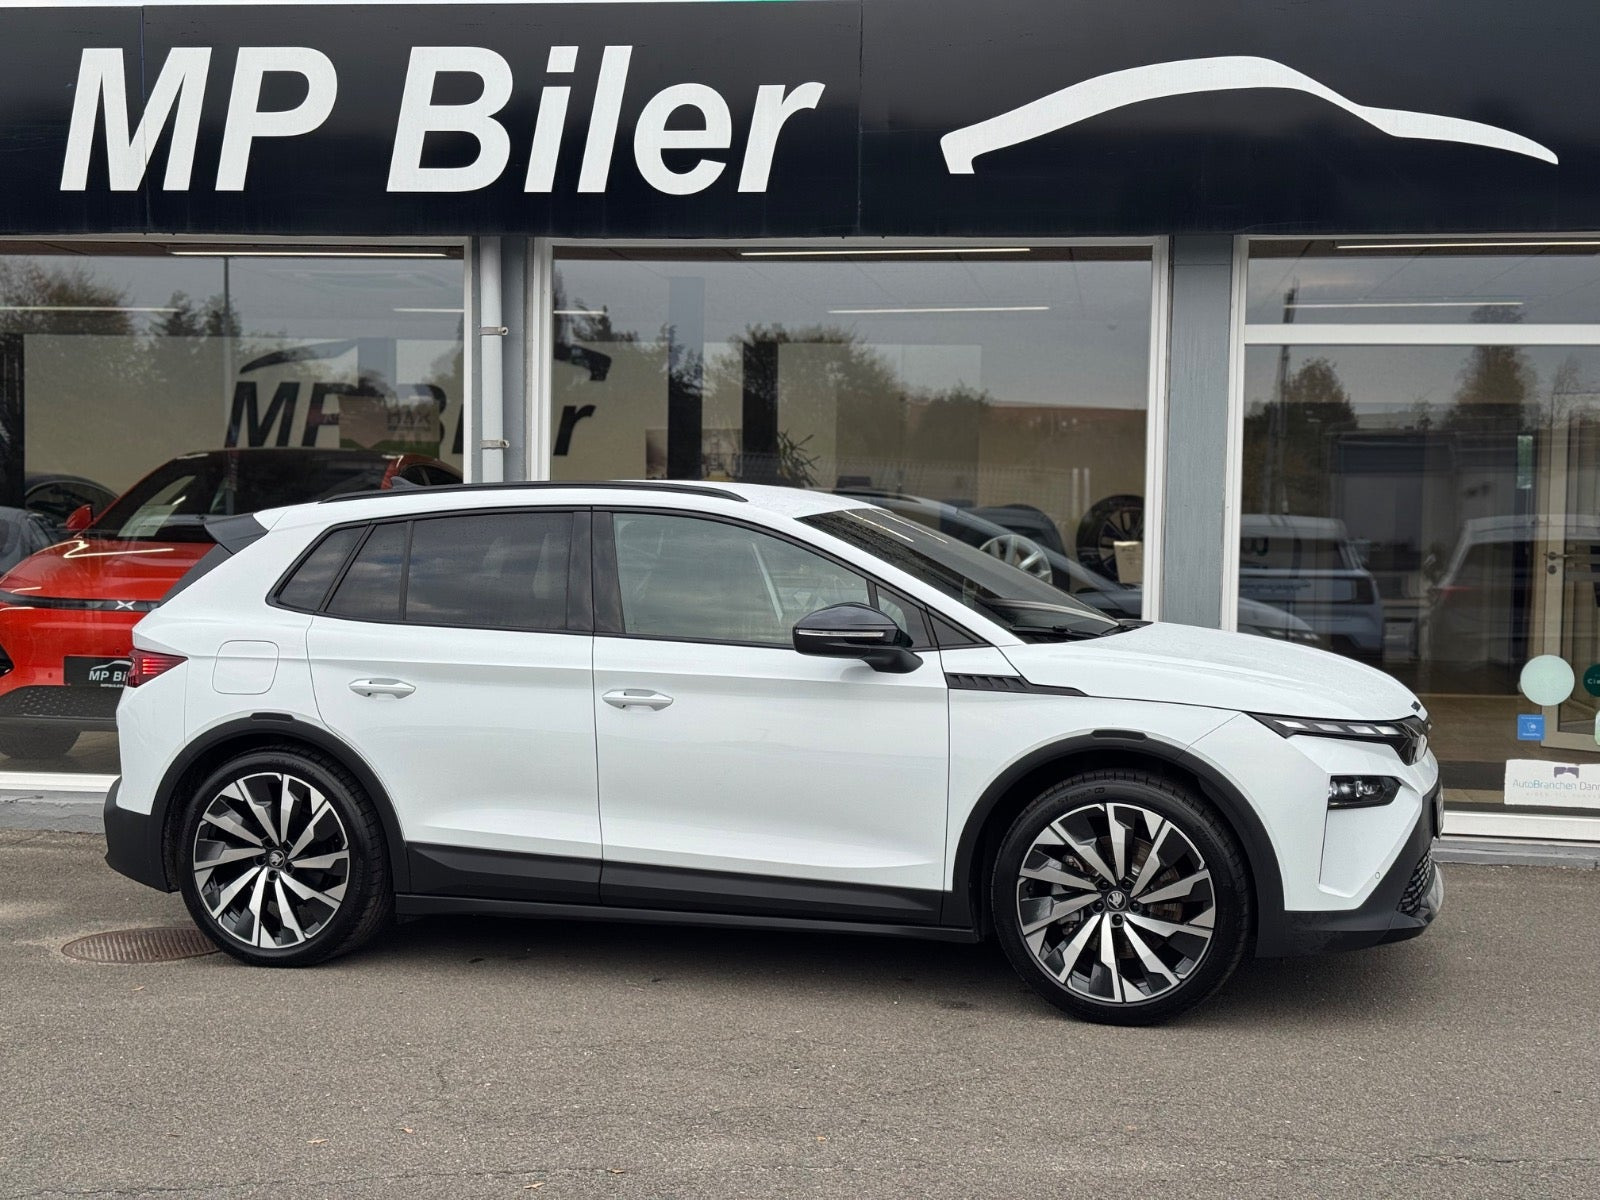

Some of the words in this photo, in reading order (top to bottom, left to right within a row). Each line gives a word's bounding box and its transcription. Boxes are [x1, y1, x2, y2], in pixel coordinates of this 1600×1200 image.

[60, 46, 338, 192] MP
[386, 45, 826, 195] Biler
[88, 670, 109, 682] MP
[1512, 779, 1577, 791] AutoBranchen
